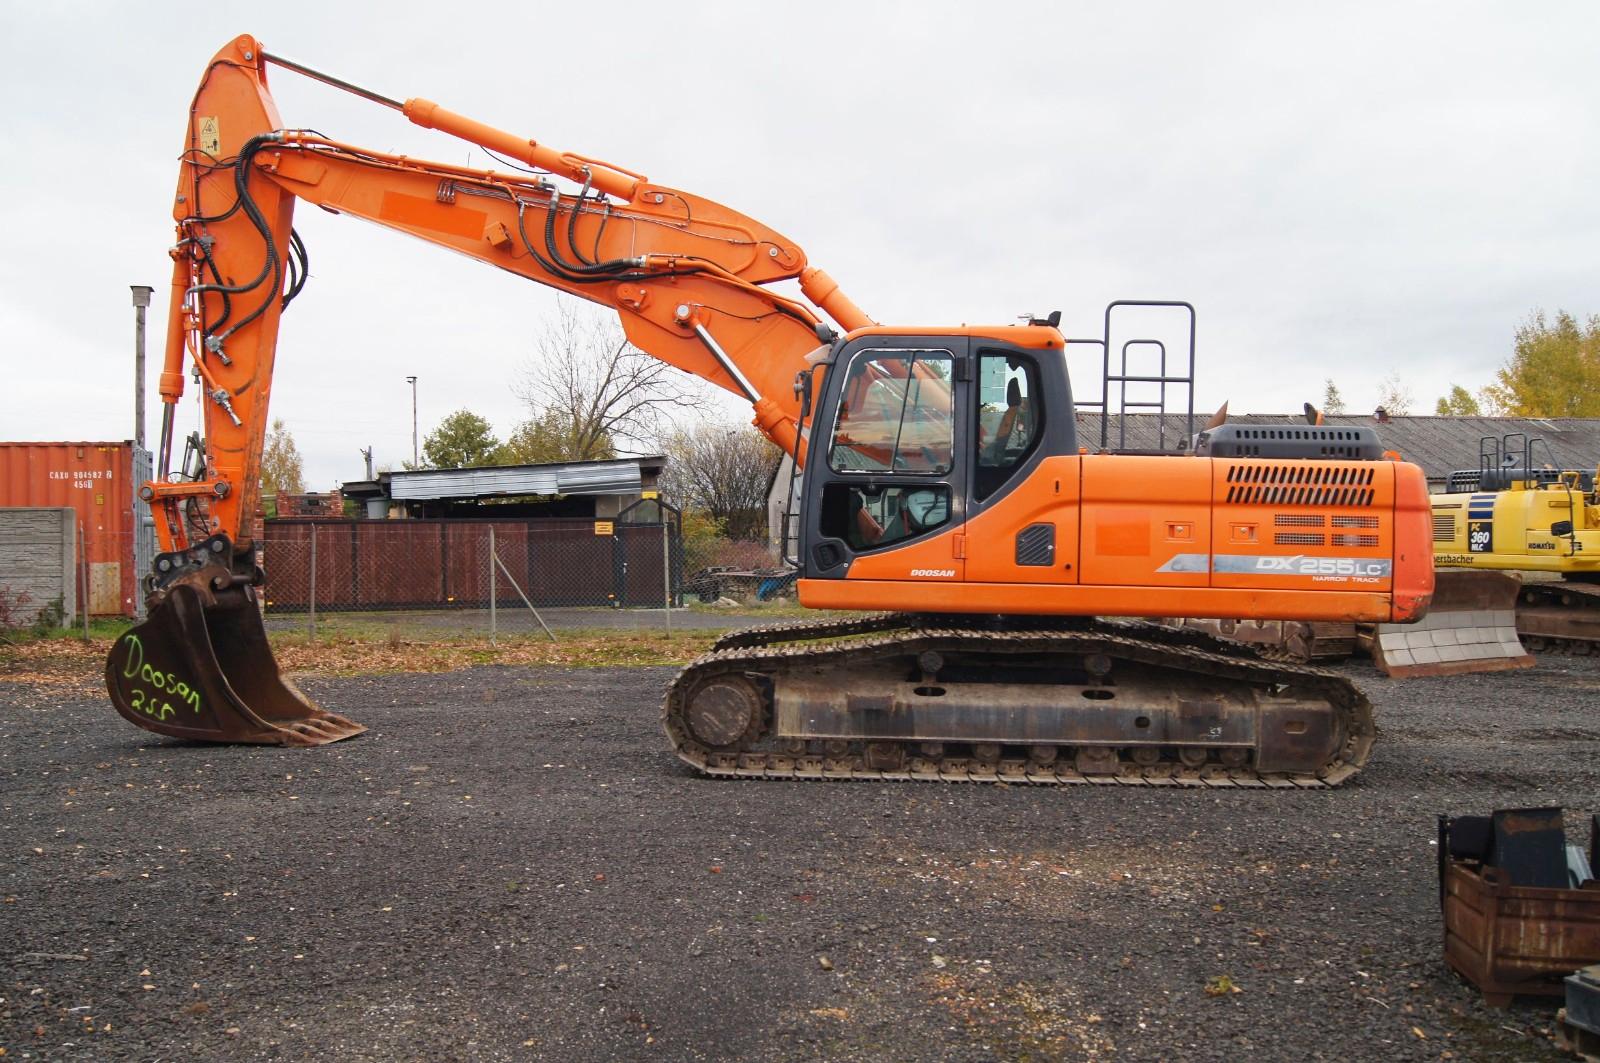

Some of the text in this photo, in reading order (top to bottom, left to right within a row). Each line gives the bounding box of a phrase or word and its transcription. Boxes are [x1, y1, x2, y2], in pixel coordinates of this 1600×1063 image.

[49, 471, 69, 479] CAXU
[1470, 532, 1490, 544] 360
[1528, 541, 1556, 550] KOMATSU
[911, 569, 956, 577] DOOSAN
[1312, 575, 1349, 583] NARROW
[123, 634, 200, 713] Doosan
[130, 689, 176, 721] 255
